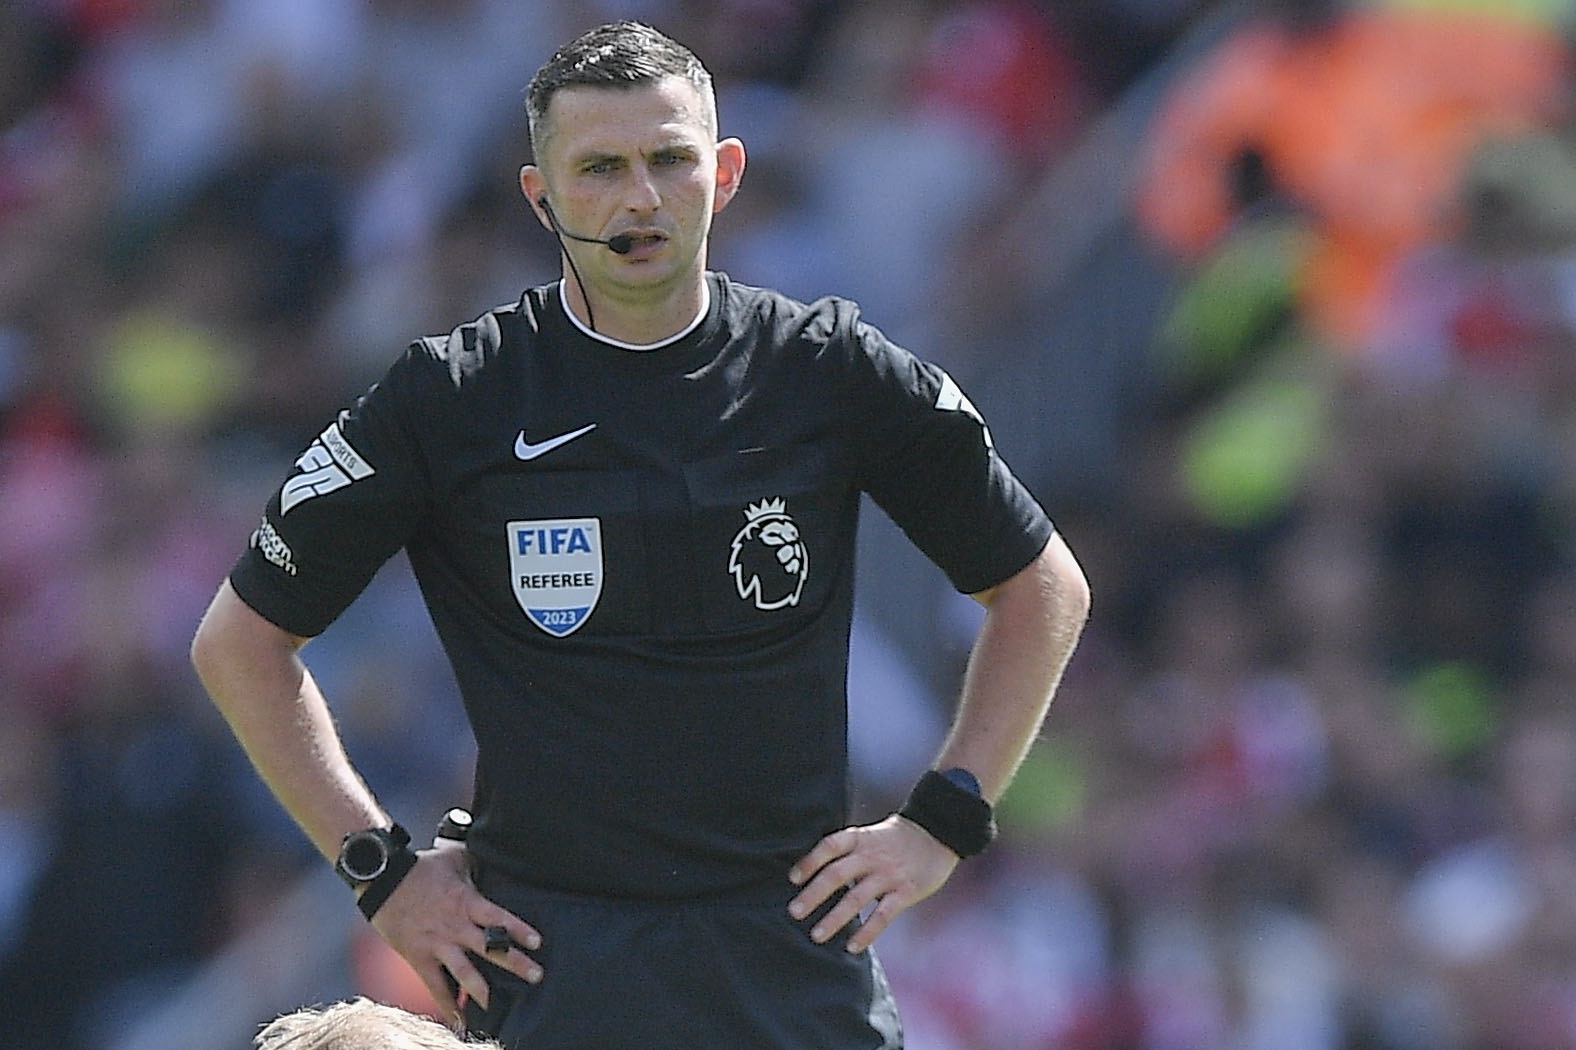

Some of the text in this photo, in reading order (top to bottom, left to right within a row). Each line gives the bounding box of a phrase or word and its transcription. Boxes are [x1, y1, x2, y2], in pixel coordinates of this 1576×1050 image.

[517, 528, 592, 556] FIFA
[520, 573, 595, 590] REFEREE
[543, 611, 576, 626] 2023
